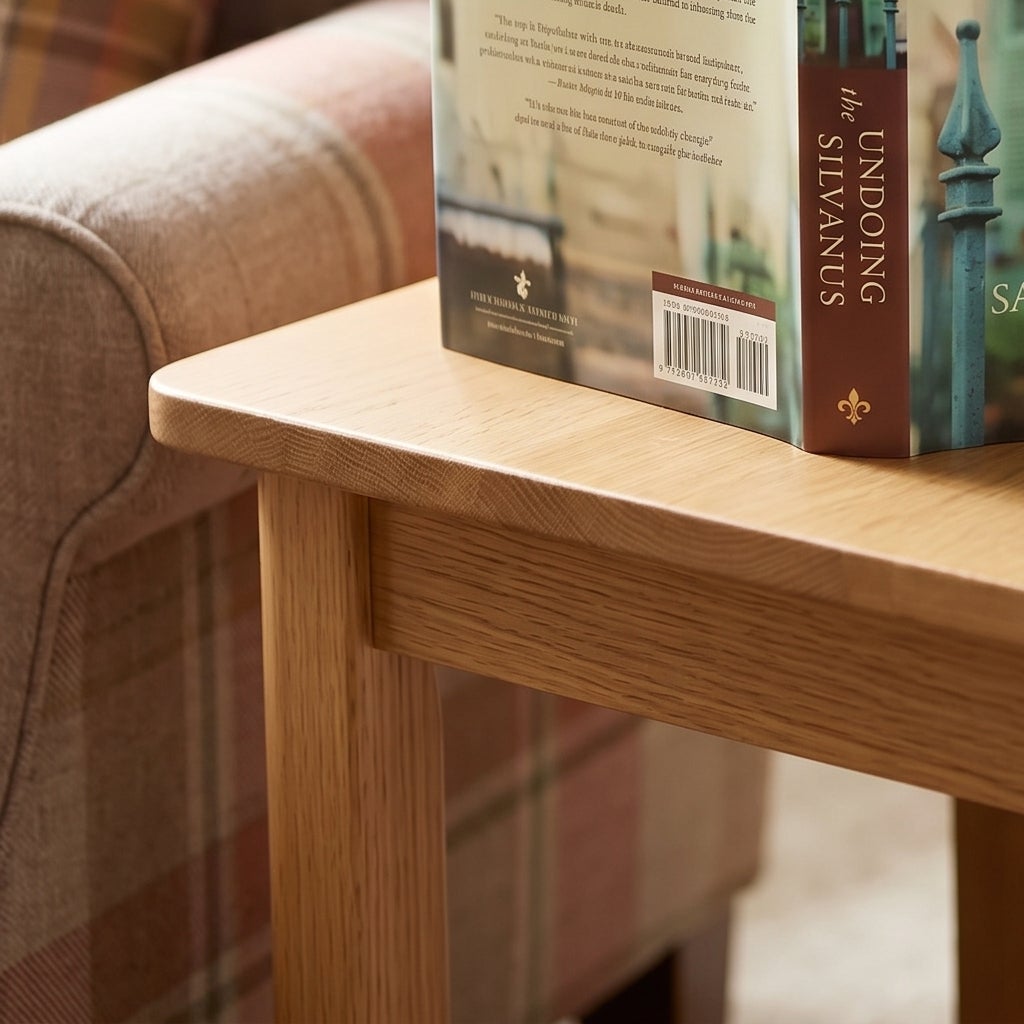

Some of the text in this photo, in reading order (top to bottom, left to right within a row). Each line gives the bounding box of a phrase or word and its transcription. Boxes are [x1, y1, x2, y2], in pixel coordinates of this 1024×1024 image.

[841, 86, 863, 123] the
[818, 134, 845, 306] SILVANUS
[858, 129, 886, 305] UNDOING
